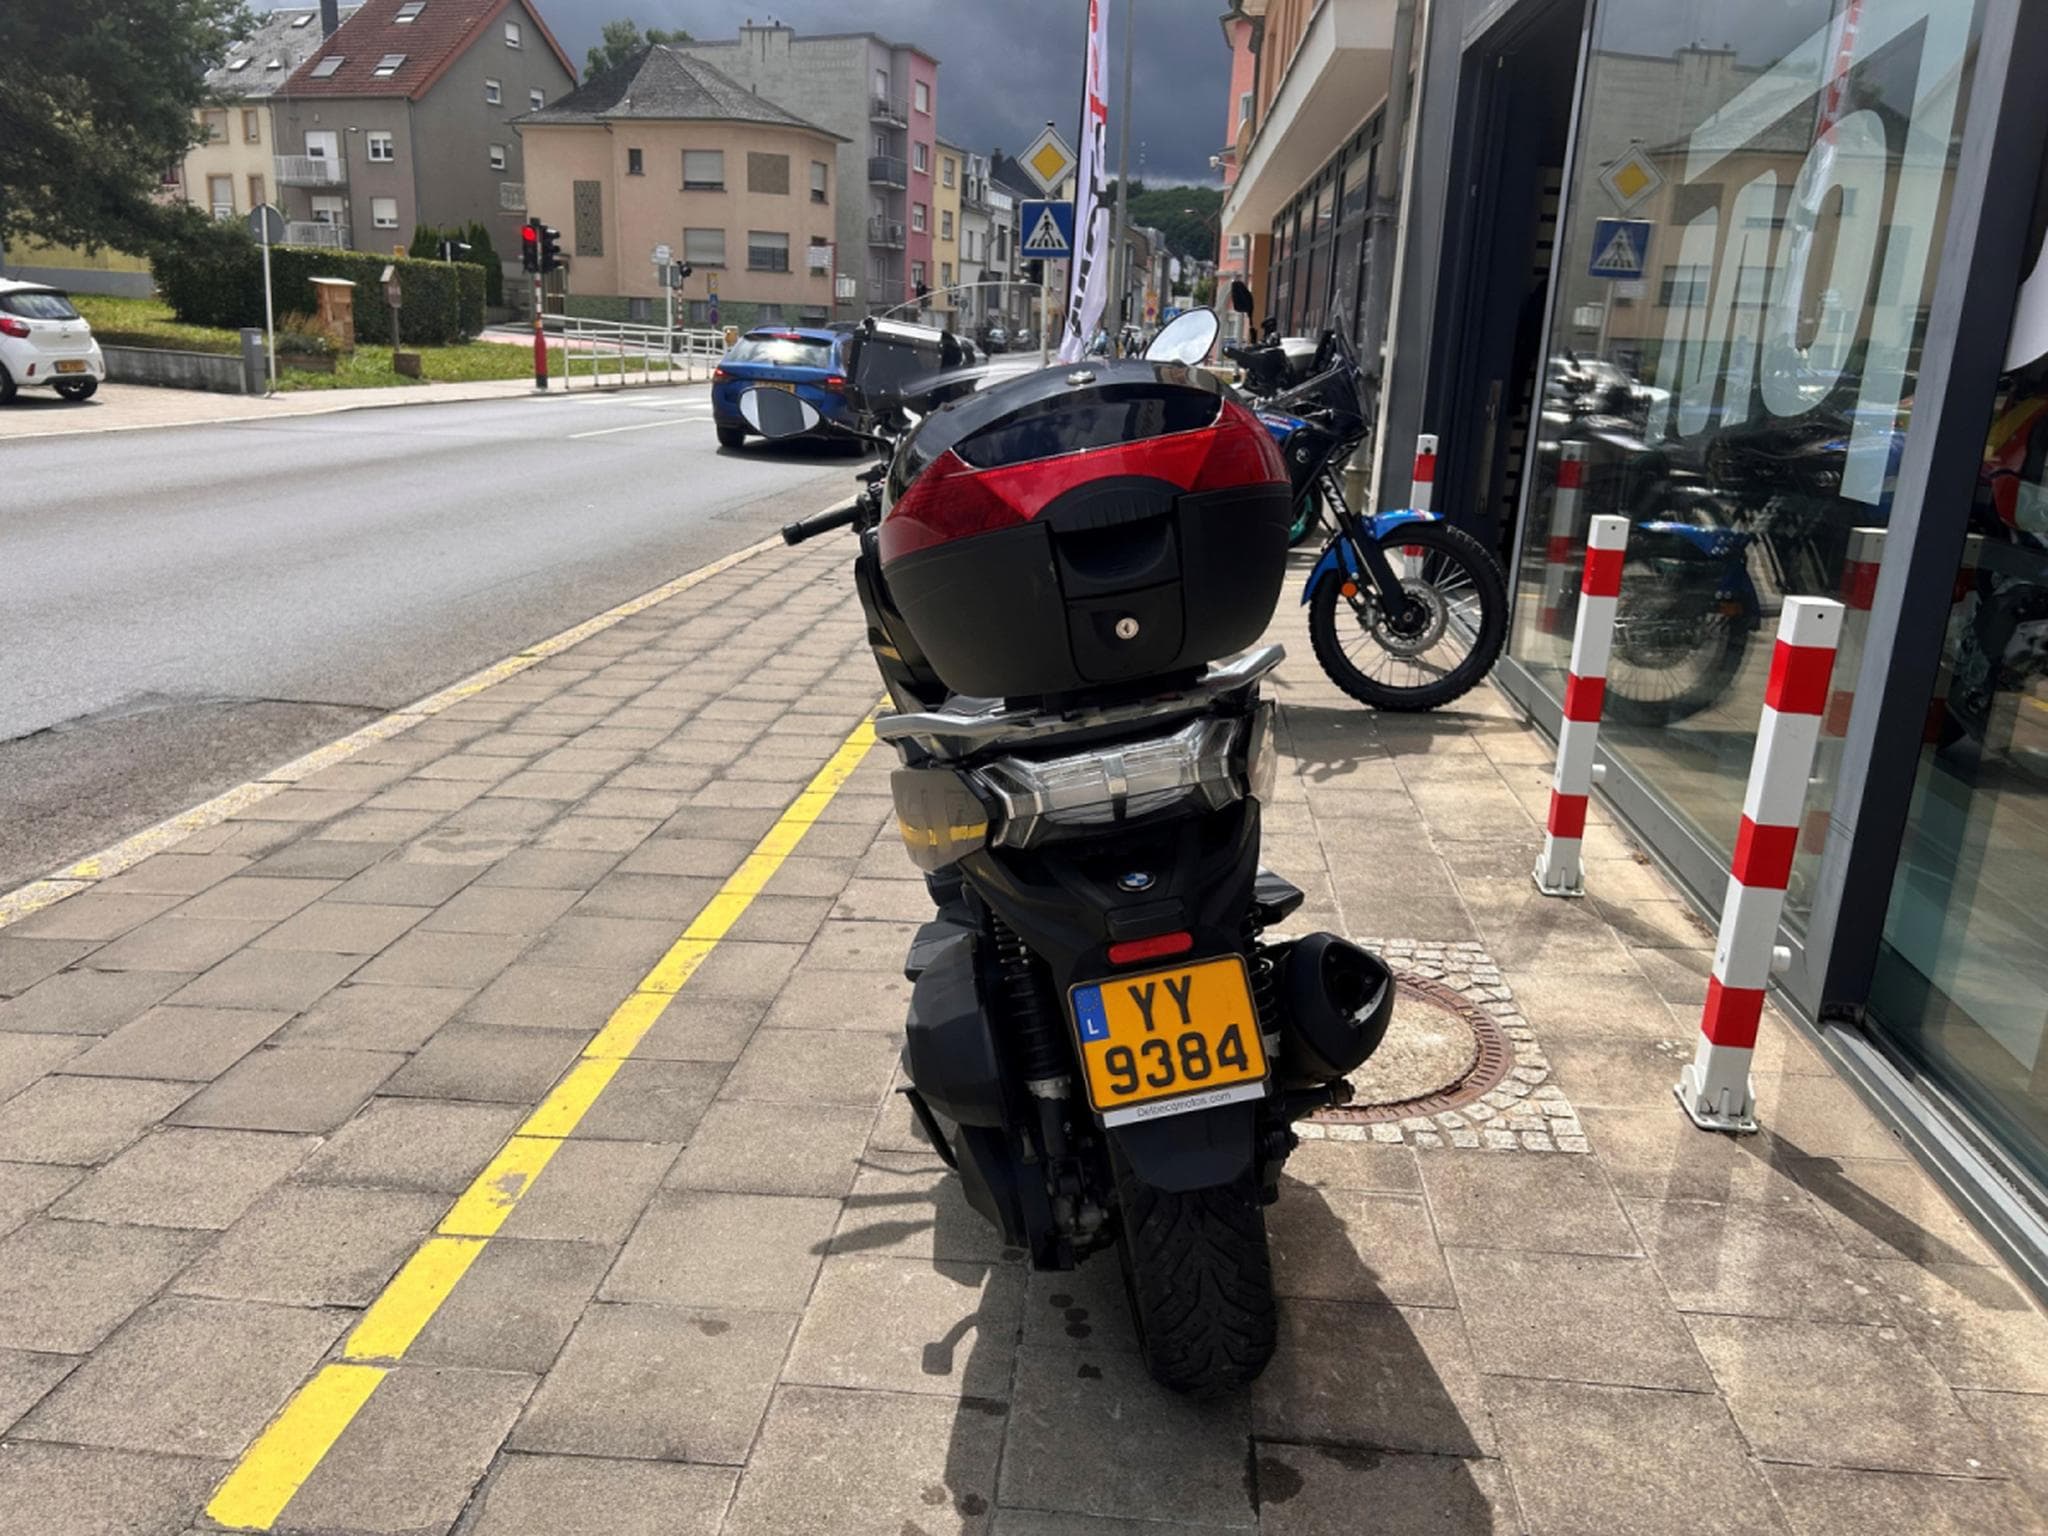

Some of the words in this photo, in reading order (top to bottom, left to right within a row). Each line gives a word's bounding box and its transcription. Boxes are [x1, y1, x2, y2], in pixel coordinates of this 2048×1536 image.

[1086, 1018, 1099, 1036] L
[1127, 974, 1192, 1032] YY
[1104, 1023, 1249, 1096] 9384
